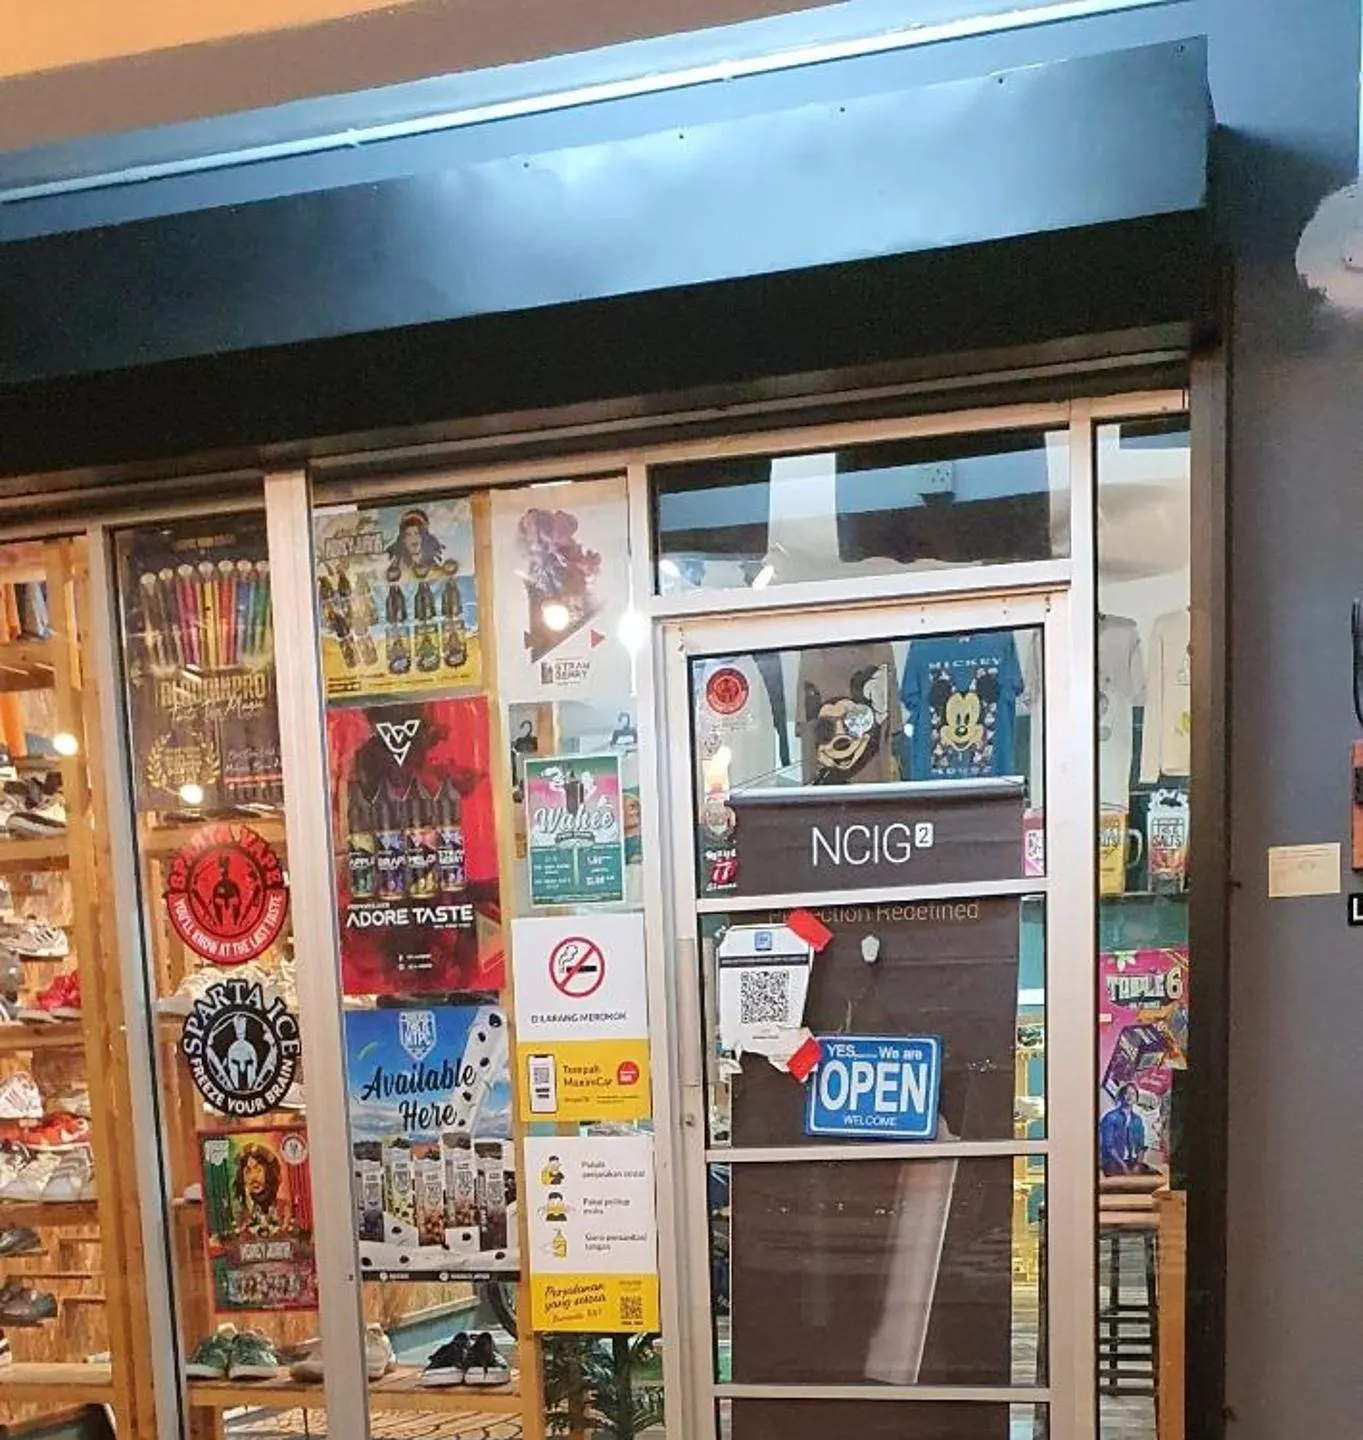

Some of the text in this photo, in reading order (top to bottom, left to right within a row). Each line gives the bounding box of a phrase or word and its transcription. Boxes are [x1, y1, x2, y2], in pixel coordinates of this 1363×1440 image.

[812, 823, 911, 867] NCIG
[346, 904, 474, 928] ADORE TASTE
[1166, 967, 1184, 999] 6
[183, 982, 300, 1056] SPARTA ICE
[878, 1045, 900, 1060] We
[190, 1057, 294, 1114] FREEZE YOUR BRAIN
[360, 1058, 476, 1101] Available
[820, 1059, 928, 1114] OPEN
[399, 1101, 458, 1133] Here
[843, 1115, 897, 1127] WELCOME
